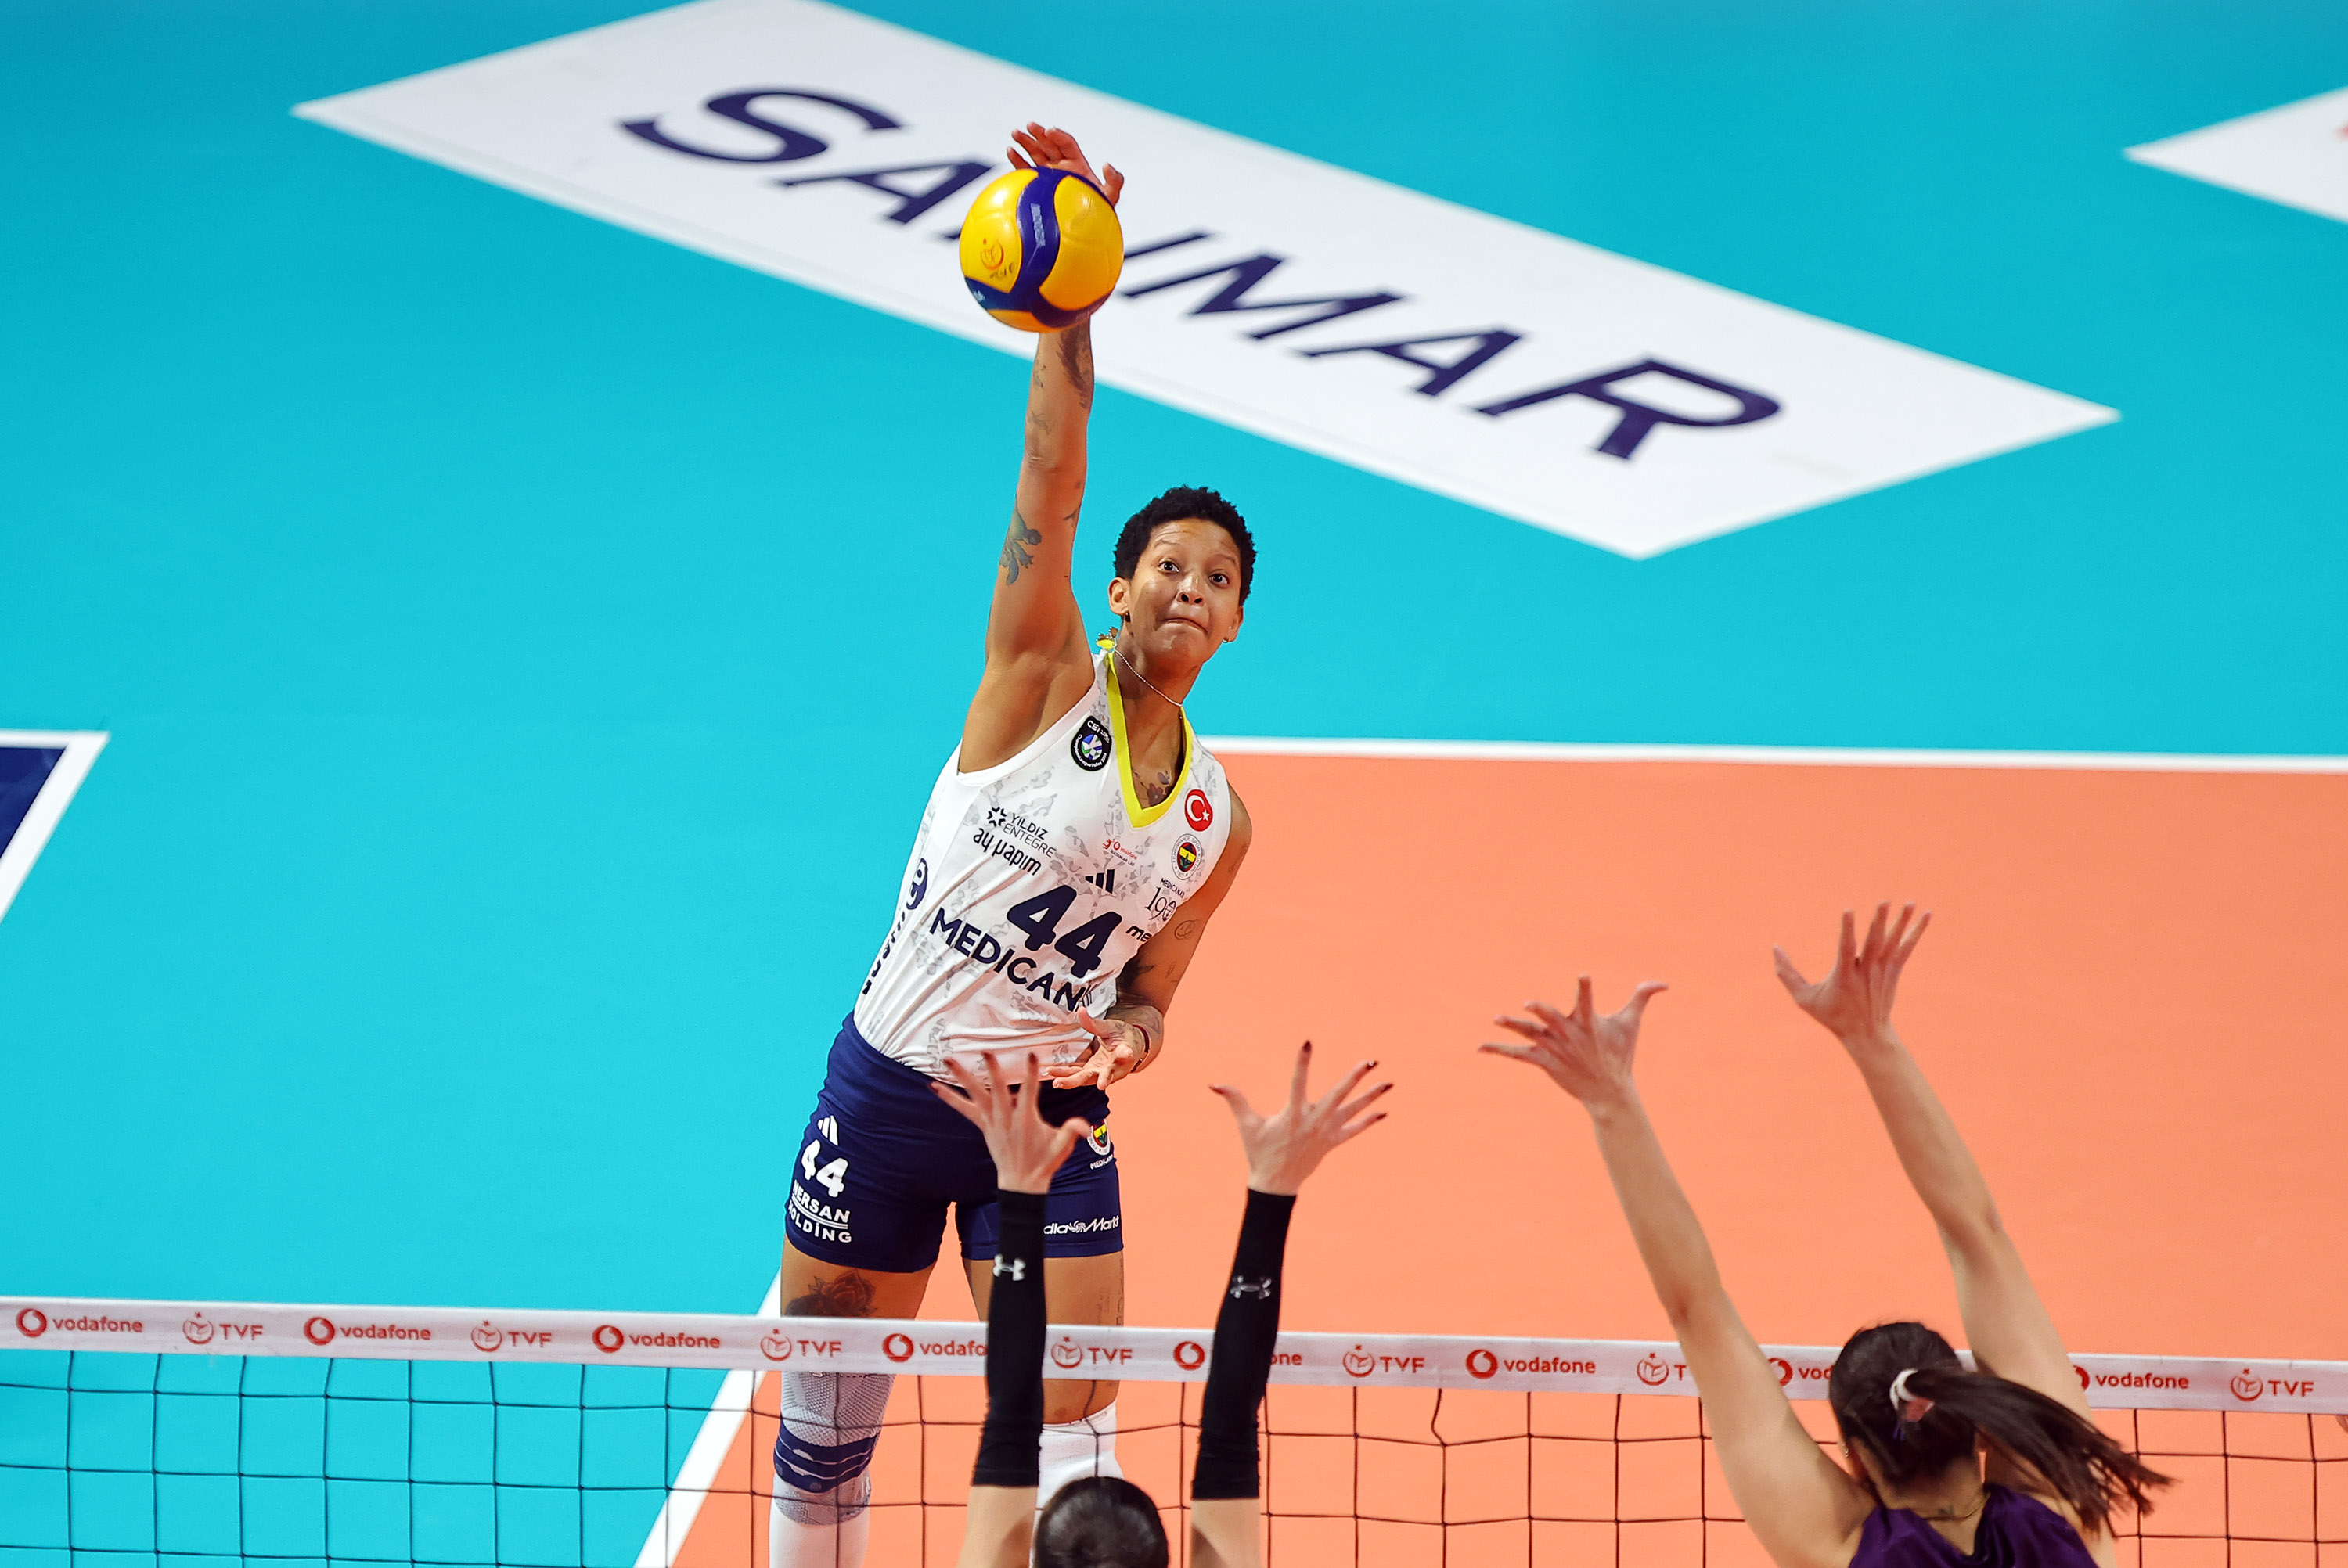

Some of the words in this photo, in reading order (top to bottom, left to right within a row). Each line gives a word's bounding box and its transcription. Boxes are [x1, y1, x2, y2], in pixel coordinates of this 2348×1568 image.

[1003, 822, 1057, 858] ENTEGRE
[1011, 812, 1048, 840] YILDIZ
[929, 907, 1097, 1012] MEDICAN
[1007, 885, 1122, 978] 44
[801, 1138, 848, 1198] 44
[52, 1316, 143, 1333] vodafone
[218, 1323, 264, 1340] TVF
[340, 1325, 432, 1341] vodafone
[507, 1331, 553, 1348] TVF
[628, 1332, 722, 1349] vodafone
[798, 1339, 843, 1358] TVF
[1087, 1347, 1133, 1365] TVF
[1379, 1356, 1425, 1374] TVF
[1503, 1357, 1597, 1376] vodafone
[2095, 1372, 2190, 1390] vodafone
[2267, 1379, 2315, 1398] TVF
